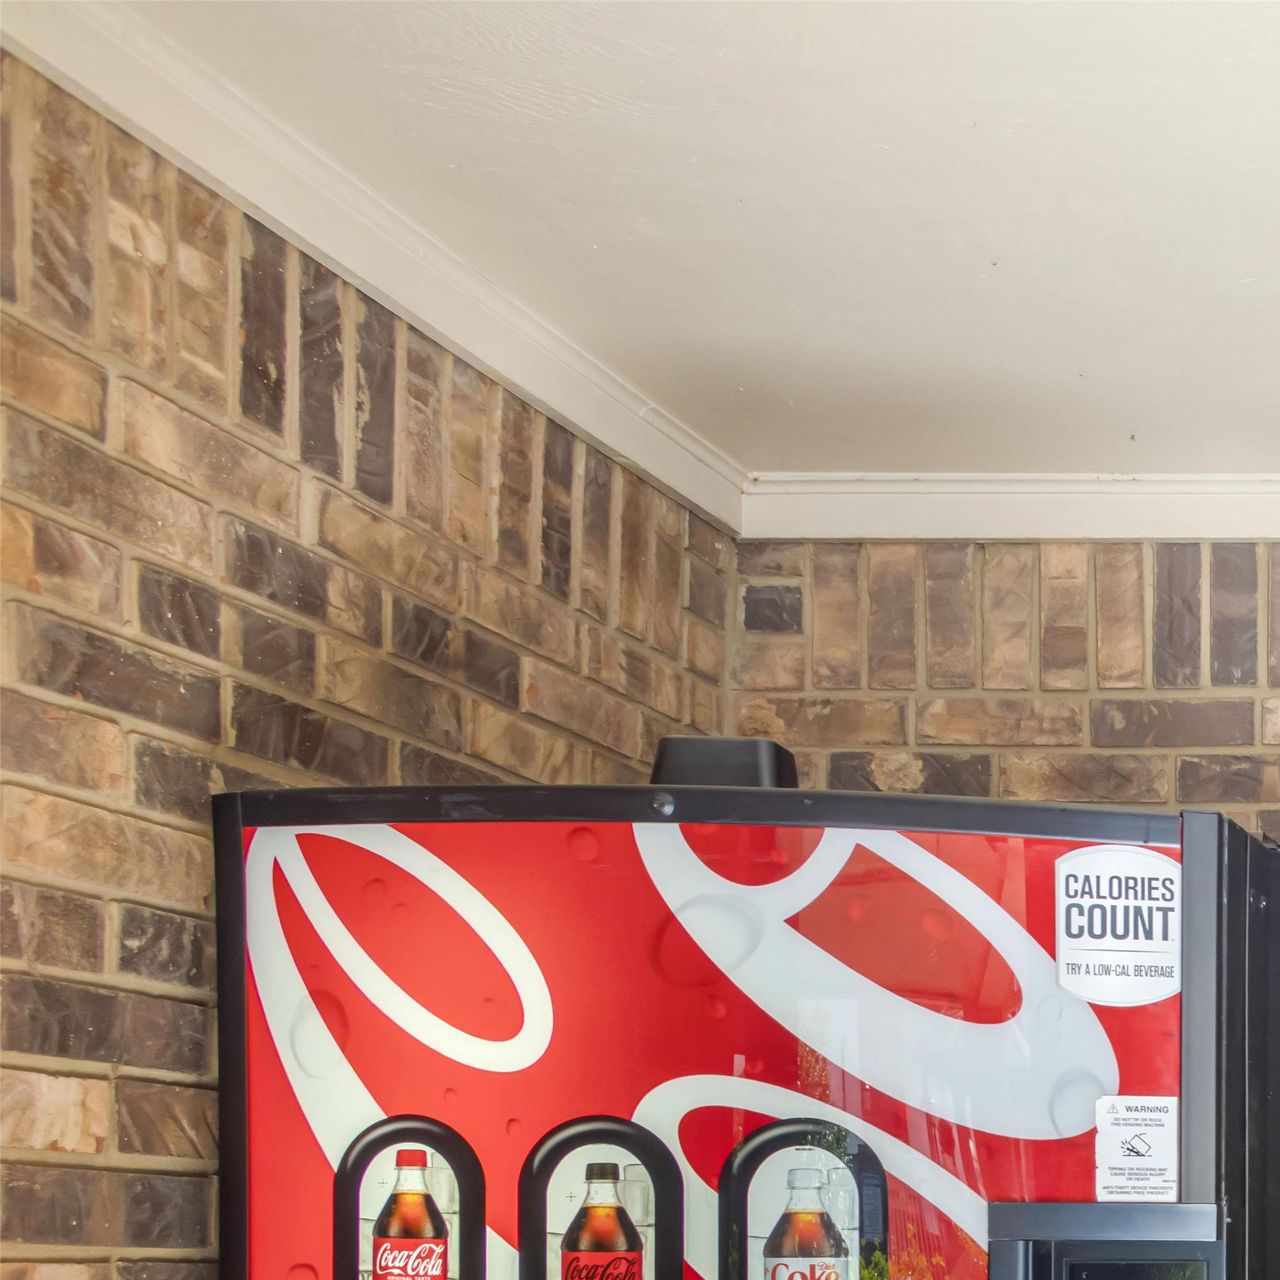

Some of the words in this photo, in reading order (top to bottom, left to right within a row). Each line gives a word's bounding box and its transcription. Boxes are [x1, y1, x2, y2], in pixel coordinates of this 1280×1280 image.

[1064, 873, 1175, 902] CALORIES
[1064, 903, 1176, 941] COUNT
[1065, 962, 1081, 977] TRY
[1084, 963, 1091, 977] A
[1093, 963, 1131, 978] LOW-CAL
[1133, 963, 1175, 979] BEVERAGE
[1125, 1105, 1169, 1114] WARNING
[376, 1242, 446, 1276] Coca-Cola
